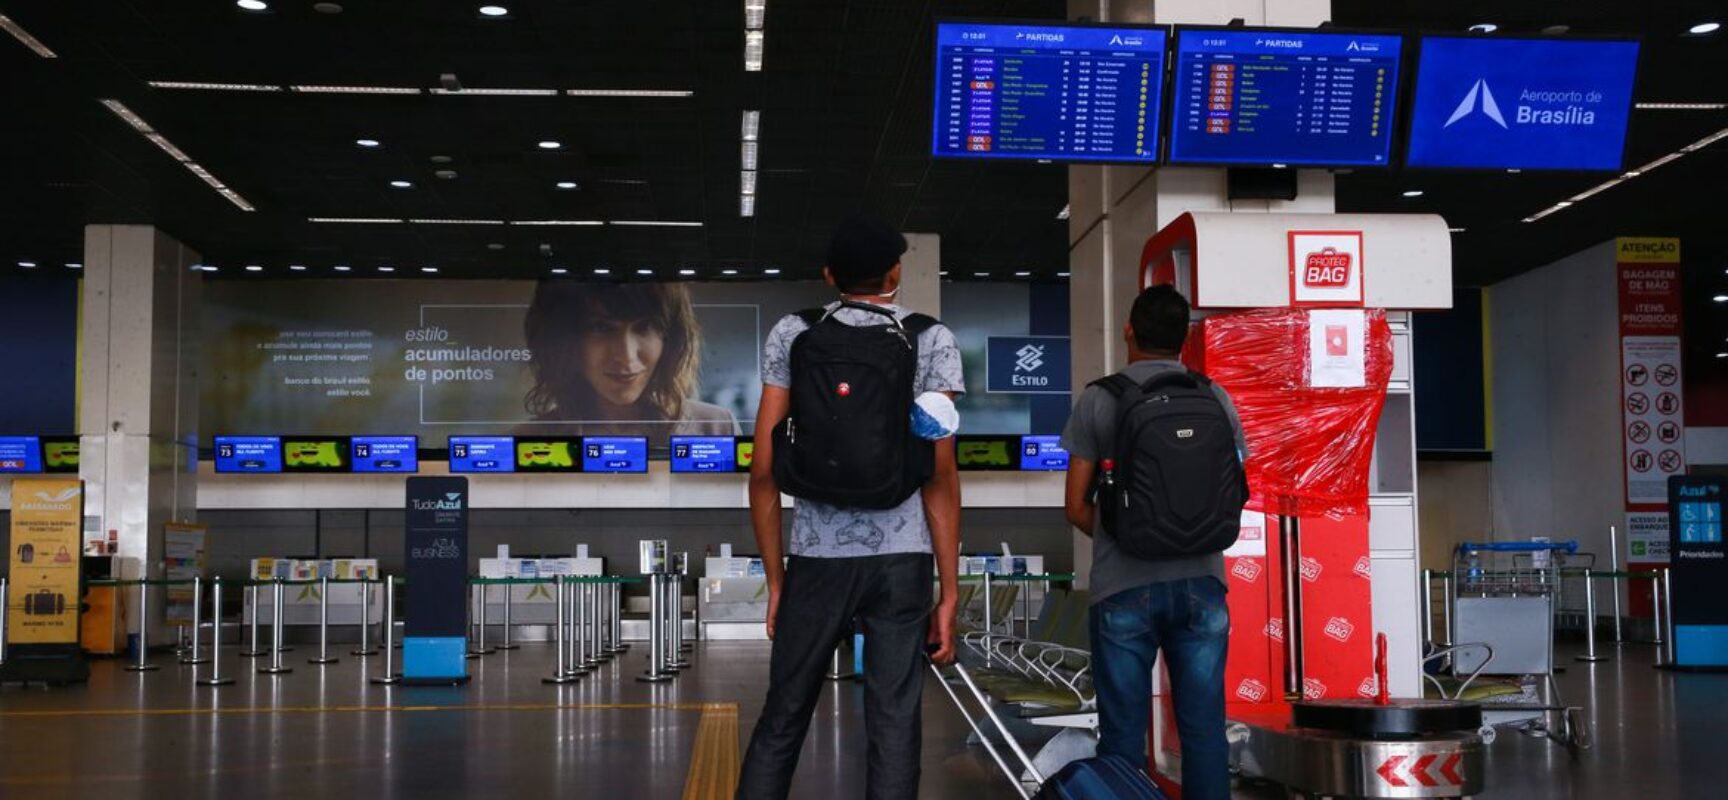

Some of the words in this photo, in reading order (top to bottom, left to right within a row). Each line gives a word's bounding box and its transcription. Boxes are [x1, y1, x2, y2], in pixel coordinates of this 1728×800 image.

[1026, 33, 1064, 42] PARTIDAS
[1266, 39, 1303, 48] PARTIDAS
[1520, 89, 1582, 103] Aeroporto
[1586, 90, 1602, 102] de
[1516, 105, 1595, 124] Brasília
[1622, 241, 1676, 254] ATENÇÃO
[1310, 257, 1347, 266] PROTEC
[1306, 267, 1345, 282] BAG
[1622, 270, 1676, 279] BAGAGEM
[1628, 280, 1643, 290] DE
[1636, 304, 1664, 312] ITENS
[1622, 314, 1678, 323] PROIBIDOS
[404, 346, 532, 361] acumuladores
[404, 366, 427, 380] de
[432, 366, 494, 384] pontos
[220, 449, 232, 457] 73
[1680, 485, 1706, 496] Azul
[412, 498, 462, 510] TudoAzul
[1680, 550, 1724, 558] Prioridades
[1234, 564, 1255, 579] BAG
[1327, 624, 1348, 638] BAG
[1238, 686, 1261, 700] BAG
[1303, 686, 1320, 699] AG
